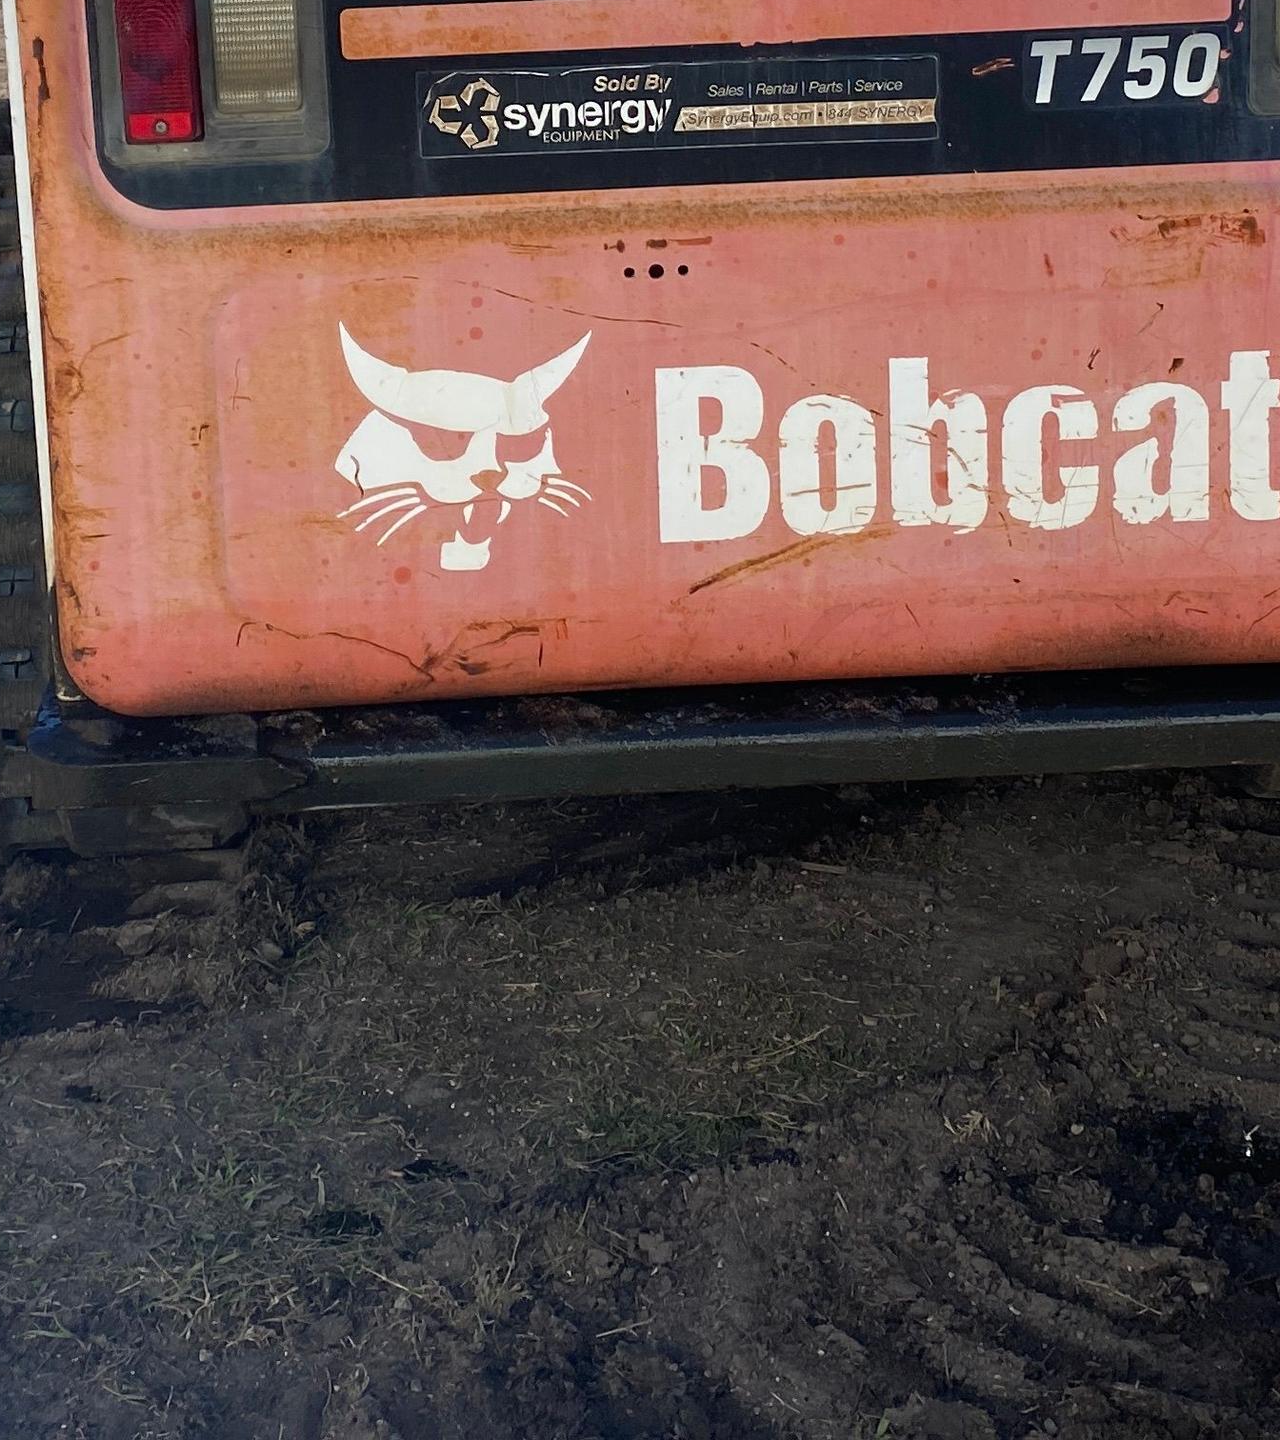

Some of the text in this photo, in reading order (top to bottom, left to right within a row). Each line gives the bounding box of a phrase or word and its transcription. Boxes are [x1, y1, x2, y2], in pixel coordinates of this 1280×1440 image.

[1029, 32, 1221, 104] T750
[593, 73, 672, 93] Sold By
[708, 78, 903, 98] Sales Rental Parts Service
[503, 98, 672, 137] synergy
[858, 104, 927, 120] SYNERGY
[542, 129, 620, 144] EQUIPMENT
[654, 350, 1280, 543] Bobcat
